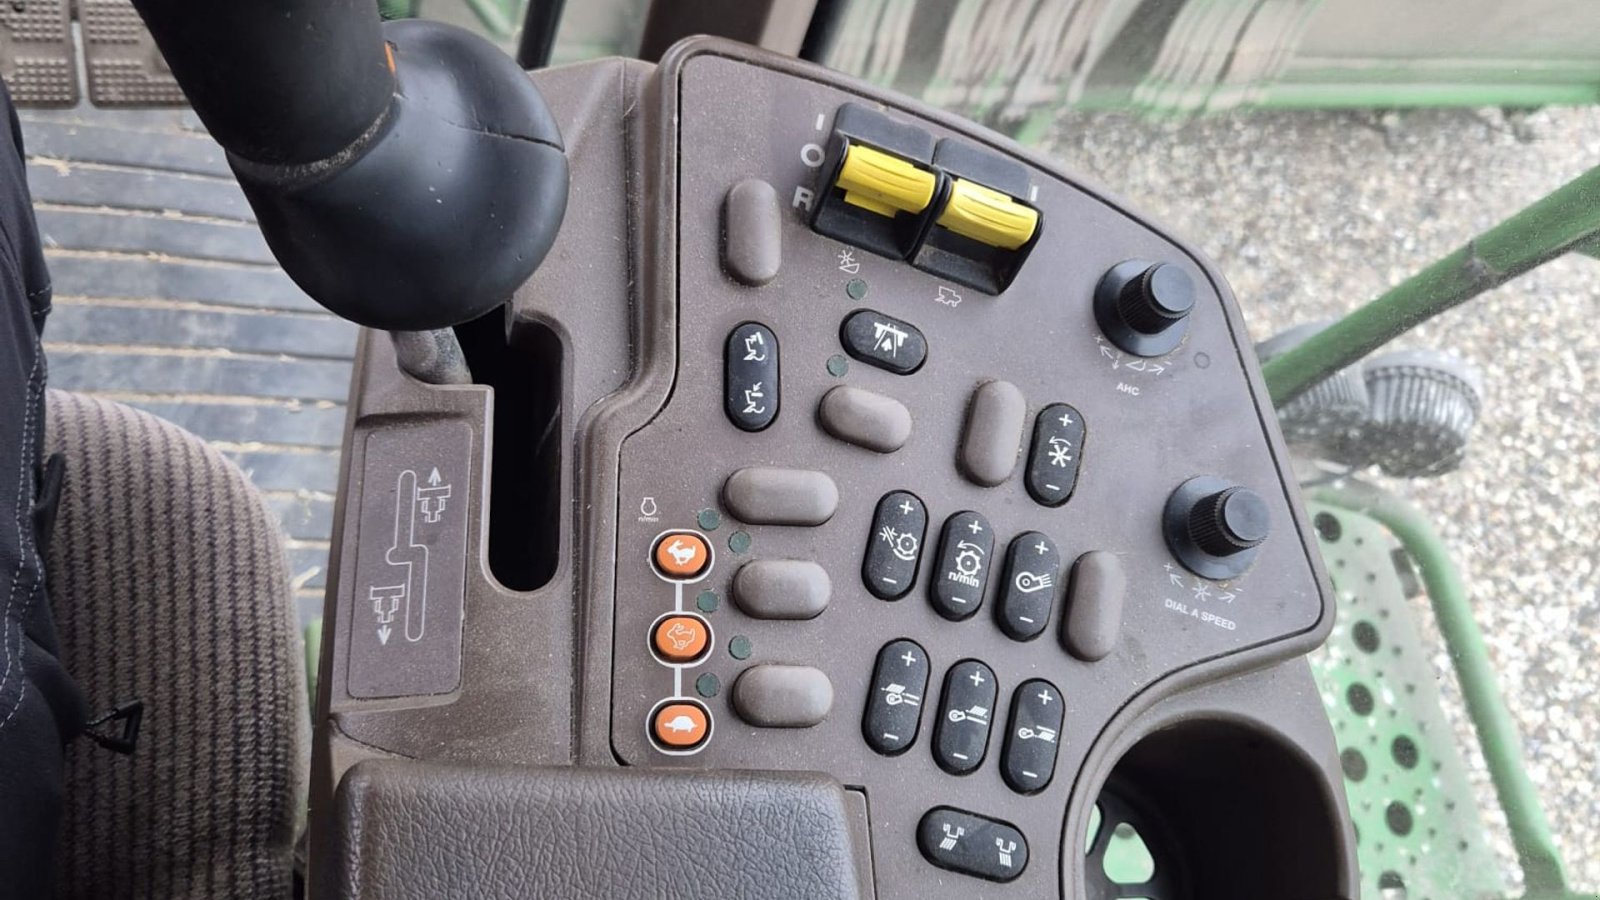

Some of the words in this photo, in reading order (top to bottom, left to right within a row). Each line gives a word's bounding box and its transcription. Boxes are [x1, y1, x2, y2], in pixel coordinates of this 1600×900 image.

[792, 185, 815, 212] R
[1116, 382, 1141, 396] AHC
[948, 571, 980, 588] n/min
[1164, 598, 1189, 615] DIAL
[1190, 608, 1199, 619] A
[1201, 611, 1237, 631] SPEED
